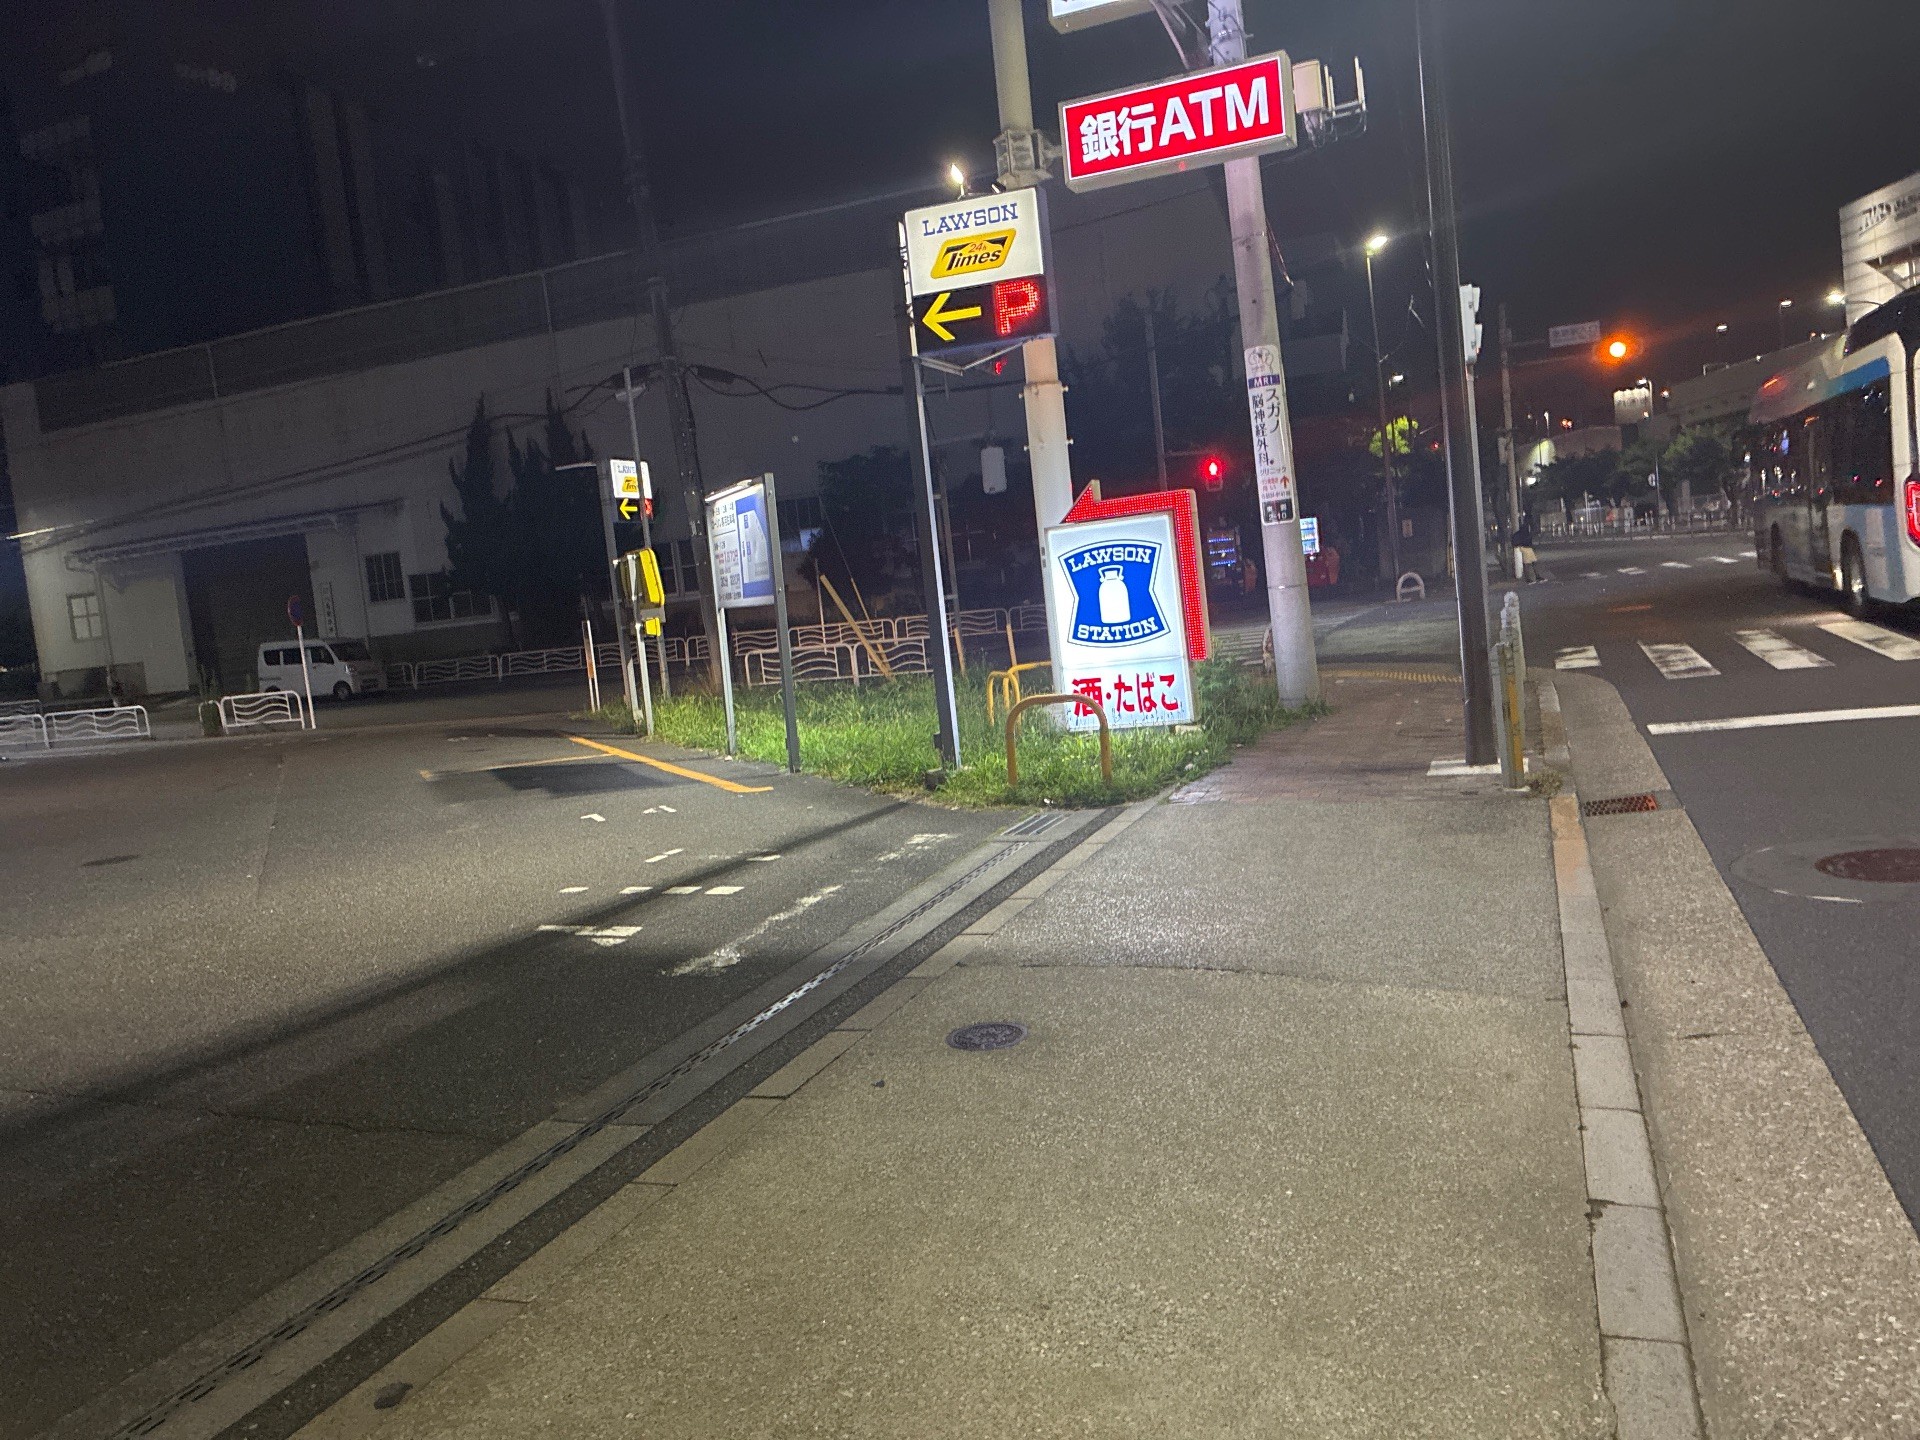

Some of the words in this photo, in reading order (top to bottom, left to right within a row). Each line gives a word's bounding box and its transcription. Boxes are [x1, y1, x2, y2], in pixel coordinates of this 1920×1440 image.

[1080, 76, 1269, 164] 銀行ATM
[922, 203, 1019, 236] LAWSON
[943, 246, 1002, 271] Times
[995, 281, 1039, 334] P
[1254, 376, 1274, 387] MRI
[1265, 388, 1281, 434] スガノ
[1068, 546, 1152, 572] LAWSON
[1077, 617, 1158, 641] STATION
